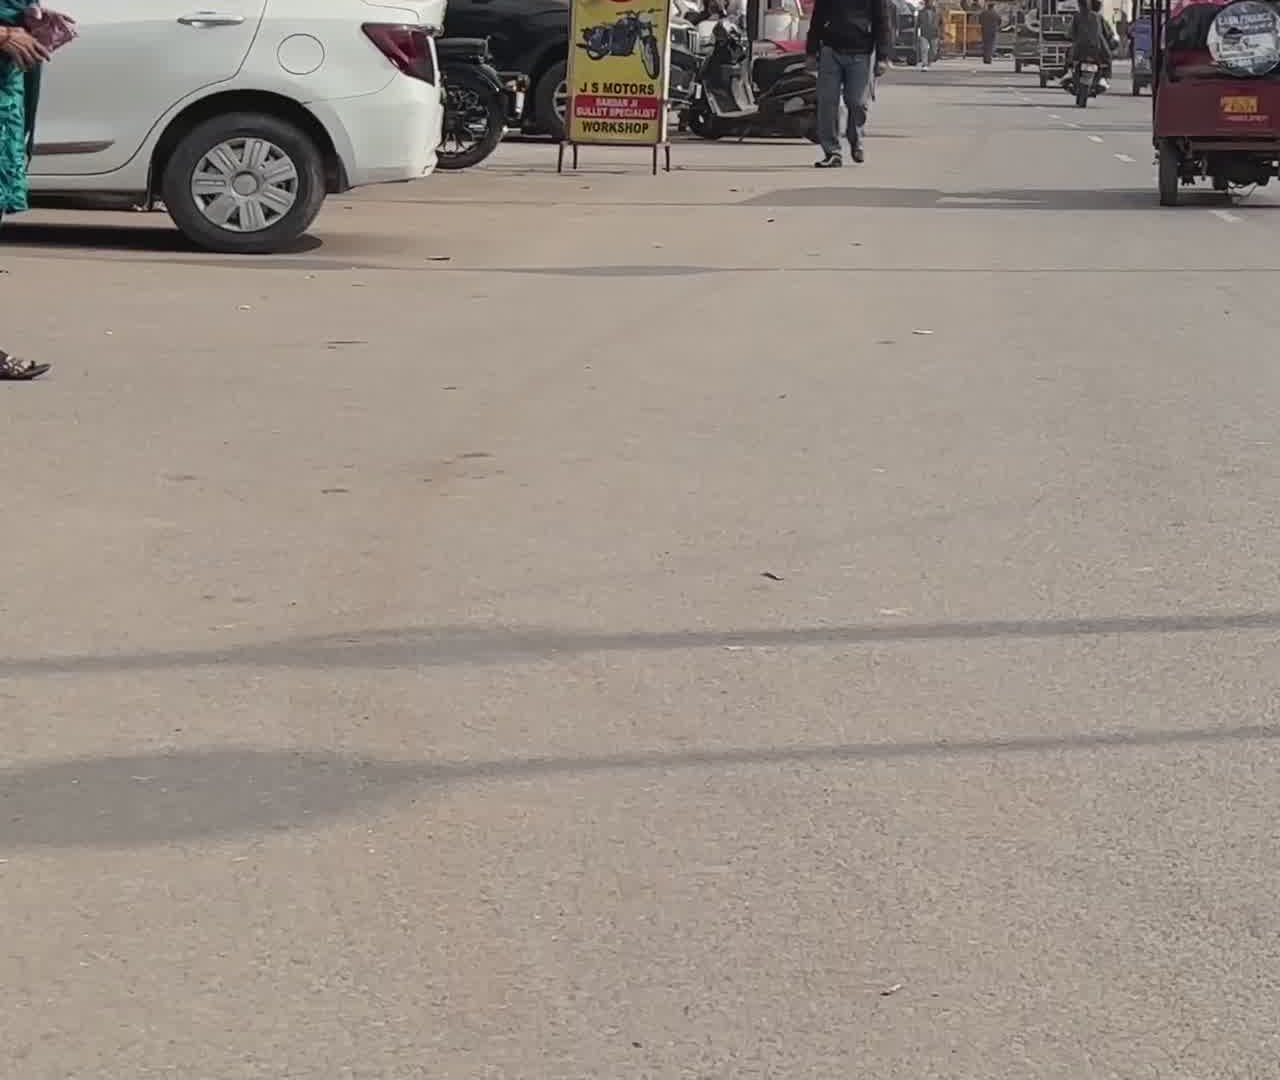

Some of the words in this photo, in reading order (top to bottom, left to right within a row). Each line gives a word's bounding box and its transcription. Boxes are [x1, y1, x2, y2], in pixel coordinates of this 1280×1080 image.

[580, 82, 588, 93] J
[591, 82, 599, 93] S
[602, 82, 655, 95] MOTORS
[582, 120, 650, 135] WORKSHOP
